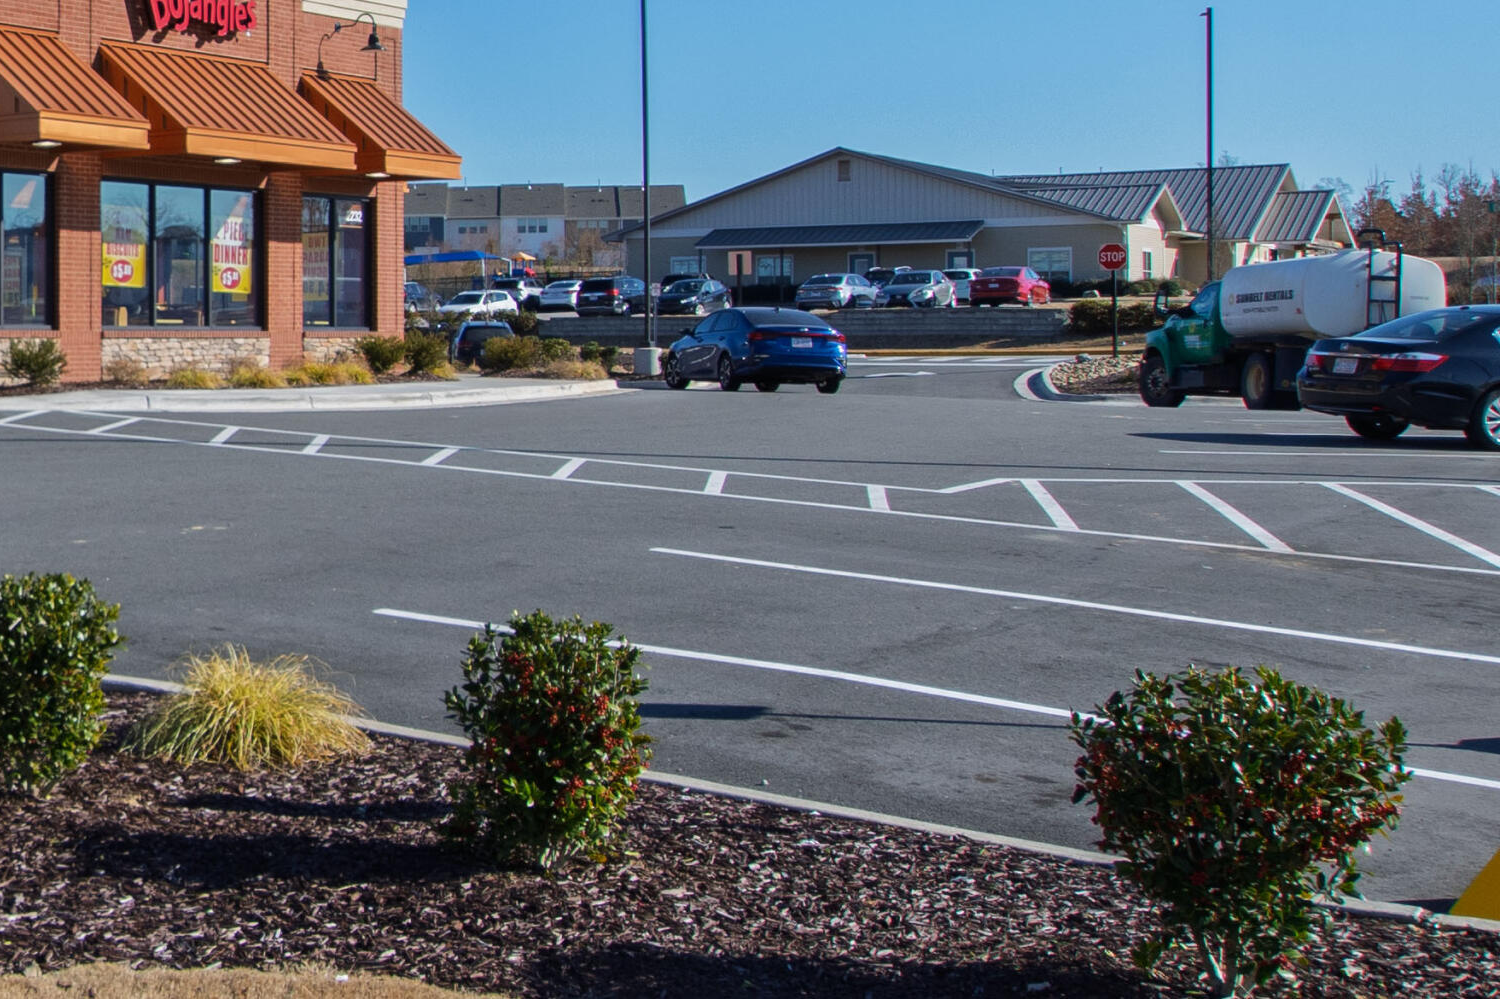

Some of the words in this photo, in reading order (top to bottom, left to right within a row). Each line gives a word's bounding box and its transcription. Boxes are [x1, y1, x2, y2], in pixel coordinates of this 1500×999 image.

[214, 243, 248, 265] DINNER
[1100, 251, 1126, 262] STOP
[1264, 289, 1294, 302] RENTALS
